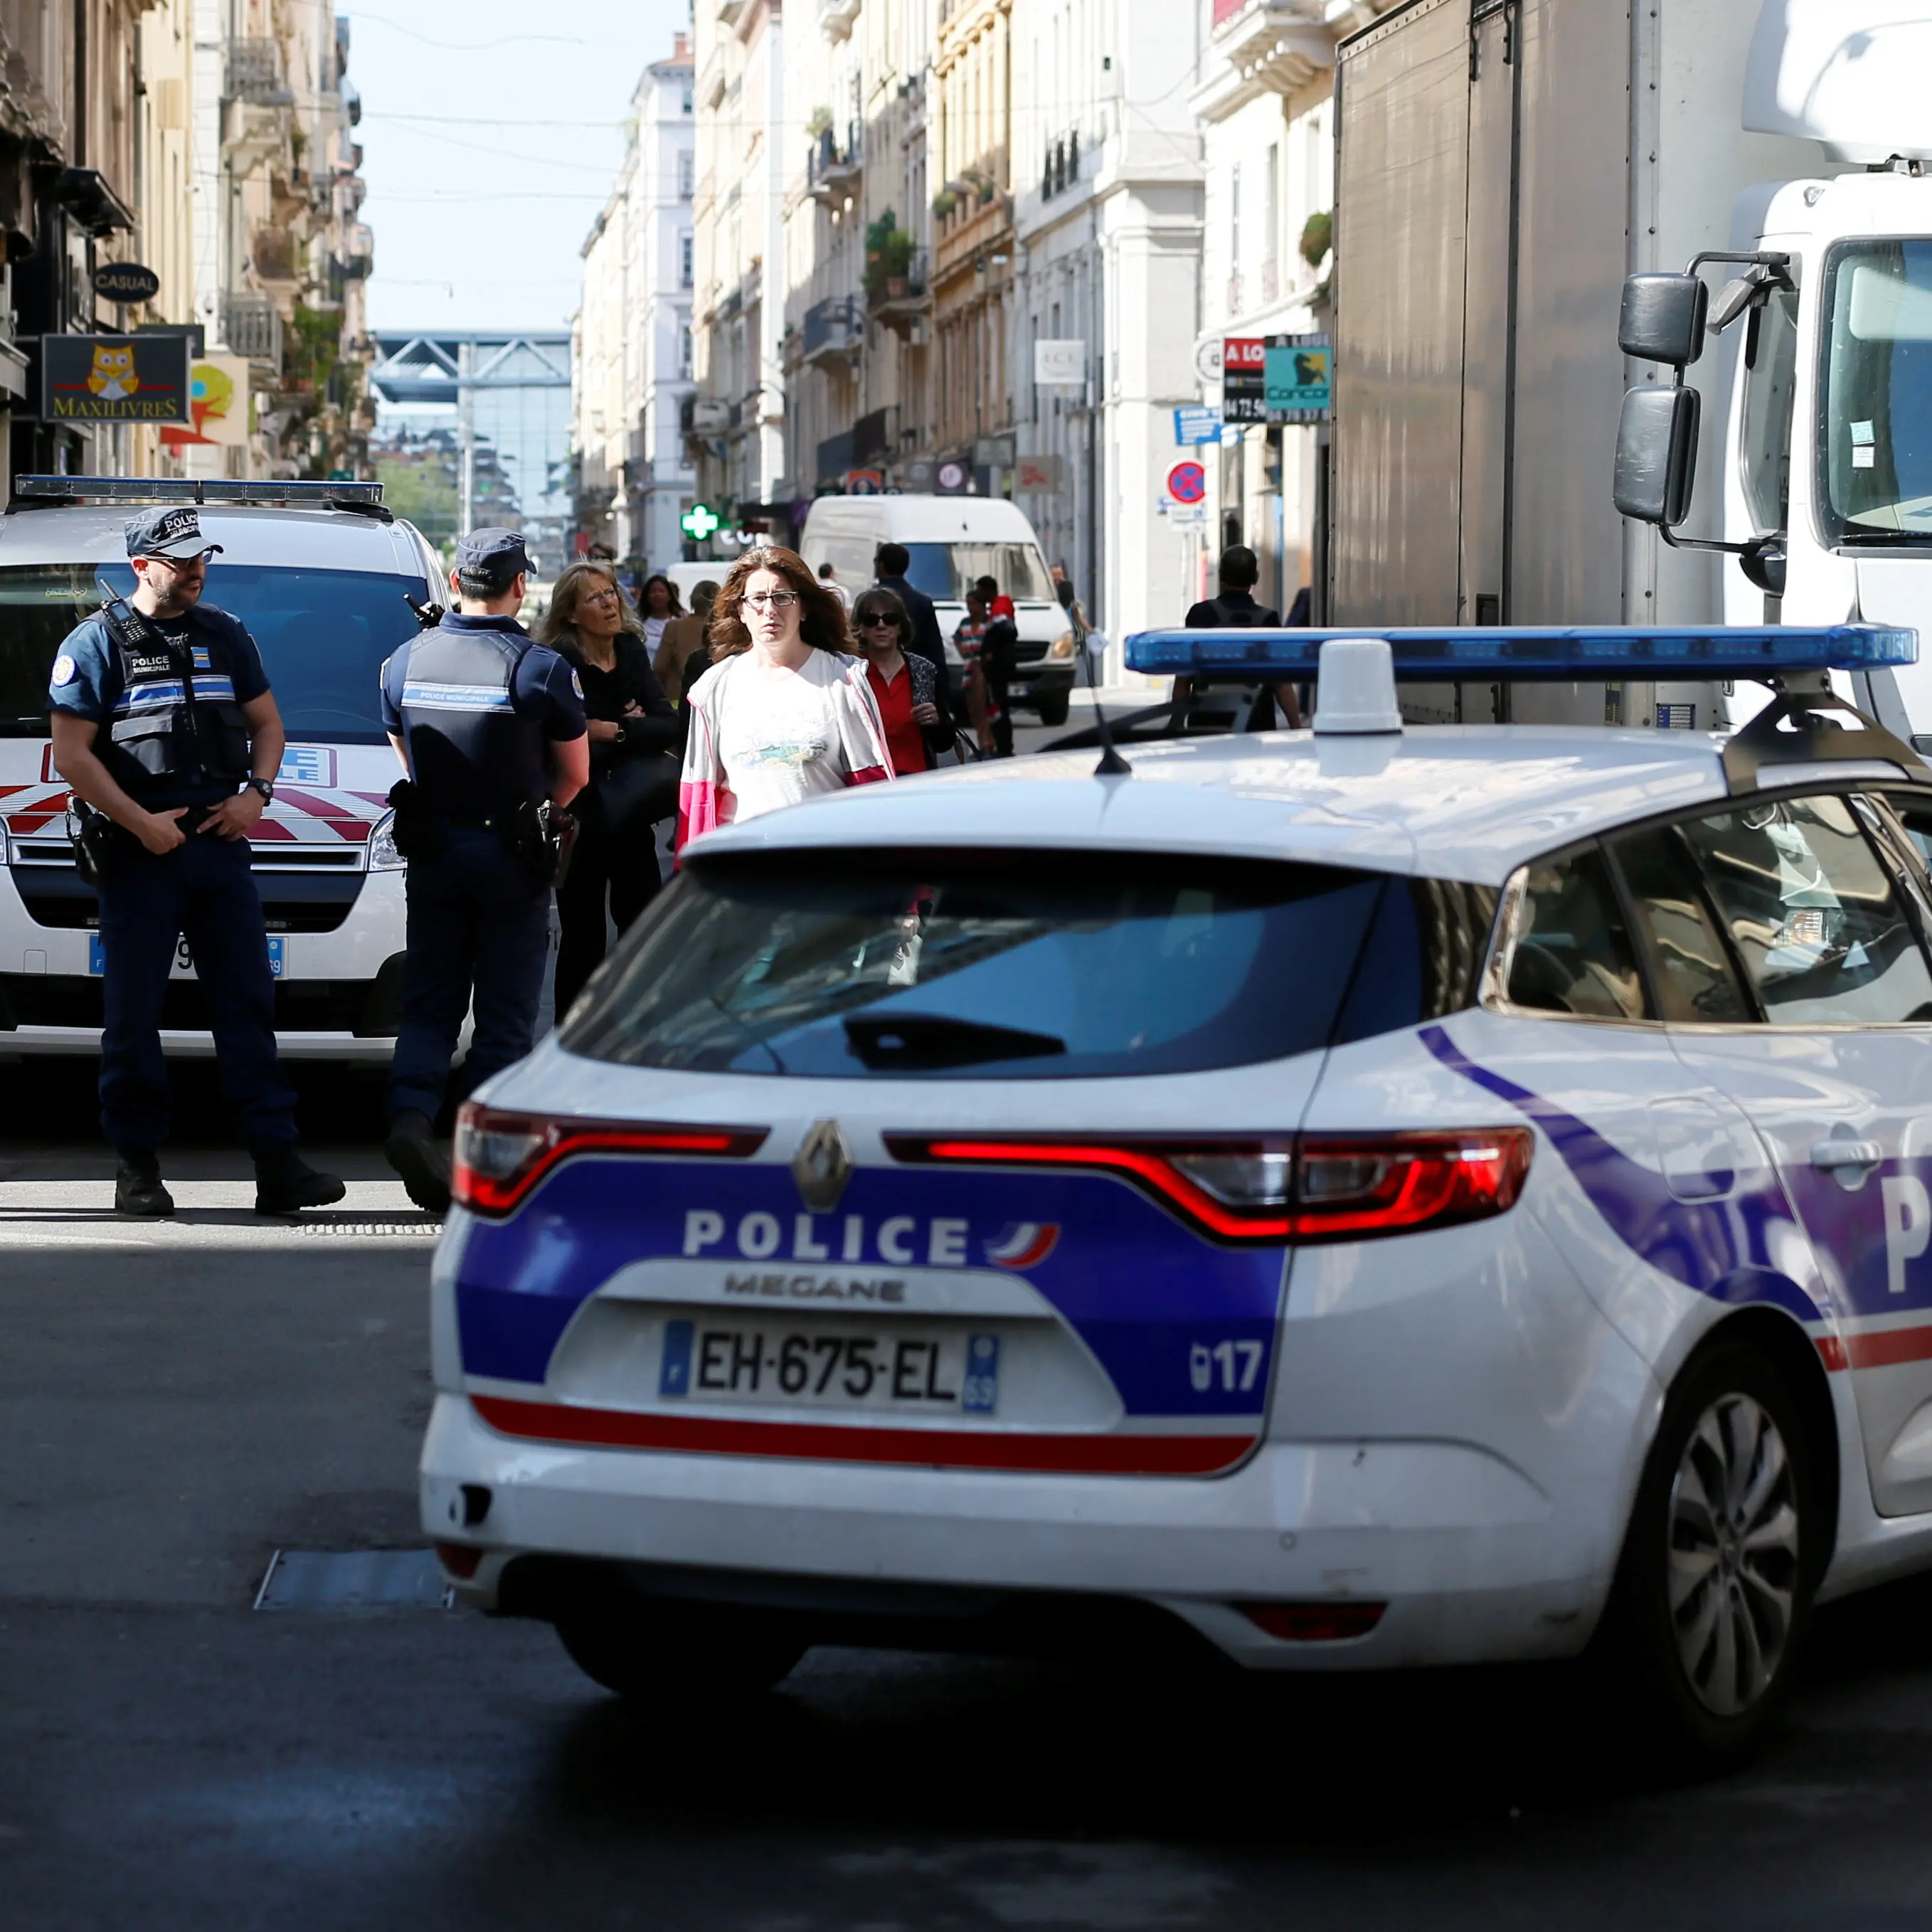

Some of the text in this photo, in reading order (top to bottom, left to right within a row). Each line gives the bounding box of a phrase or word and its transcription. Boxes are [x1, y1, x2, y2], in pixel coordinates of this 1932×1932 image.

[95, 274, 154, 291] CASUAL
[1225, 344, 1239, 361] A
[53, 396, 177, 418] MAXILIVRES
[132, 655, 169, 667] POLICE
[420, 691, 490, 702] POLICE MUNICIPALE
[682, 1209, 970, 1265] POLICE
[723, 1273, 907, 1303] MEGANE
[697, 1332, 955, 1401] EH-675-EL
[1211, 1339, 1264, 1392] 17
